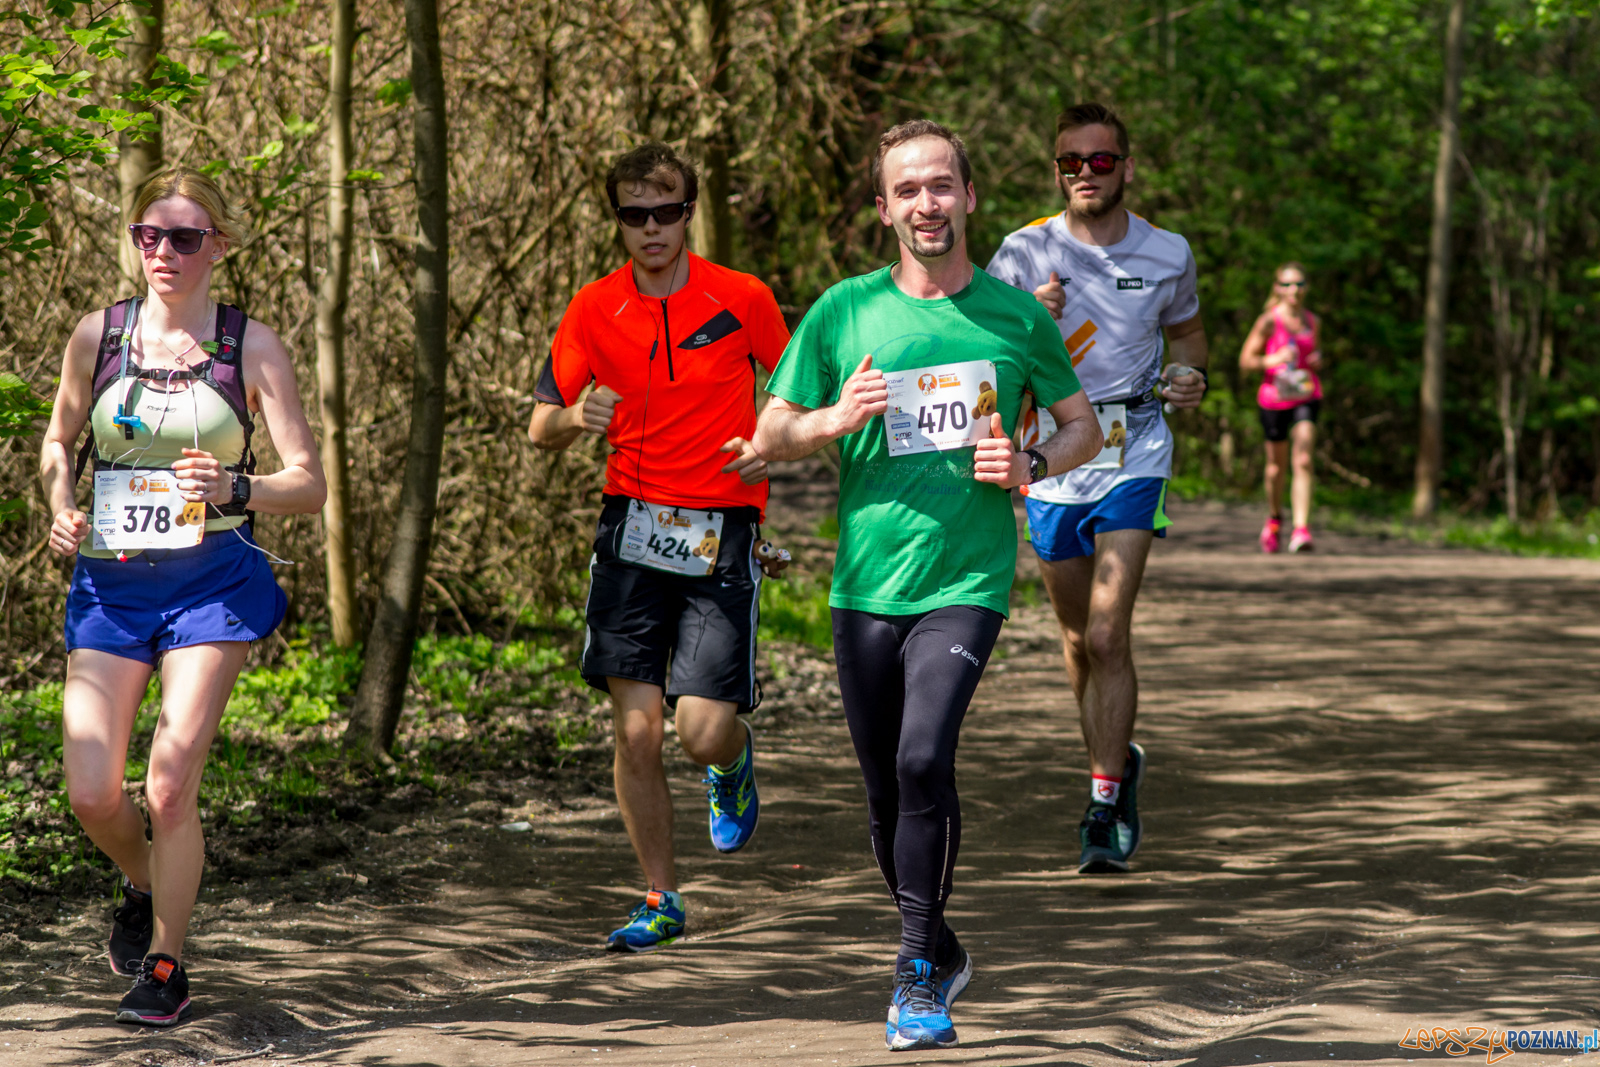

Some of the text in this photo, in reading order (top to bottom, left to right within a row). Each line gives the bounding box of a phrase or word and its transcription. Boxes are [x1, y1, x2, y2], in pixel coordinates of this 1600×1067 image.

[918, 401, 968, 434] 470
[122, 505, 171, 534] 378
[647, 532, 691, 562] 424
[961, 649, 980, 666] asics
